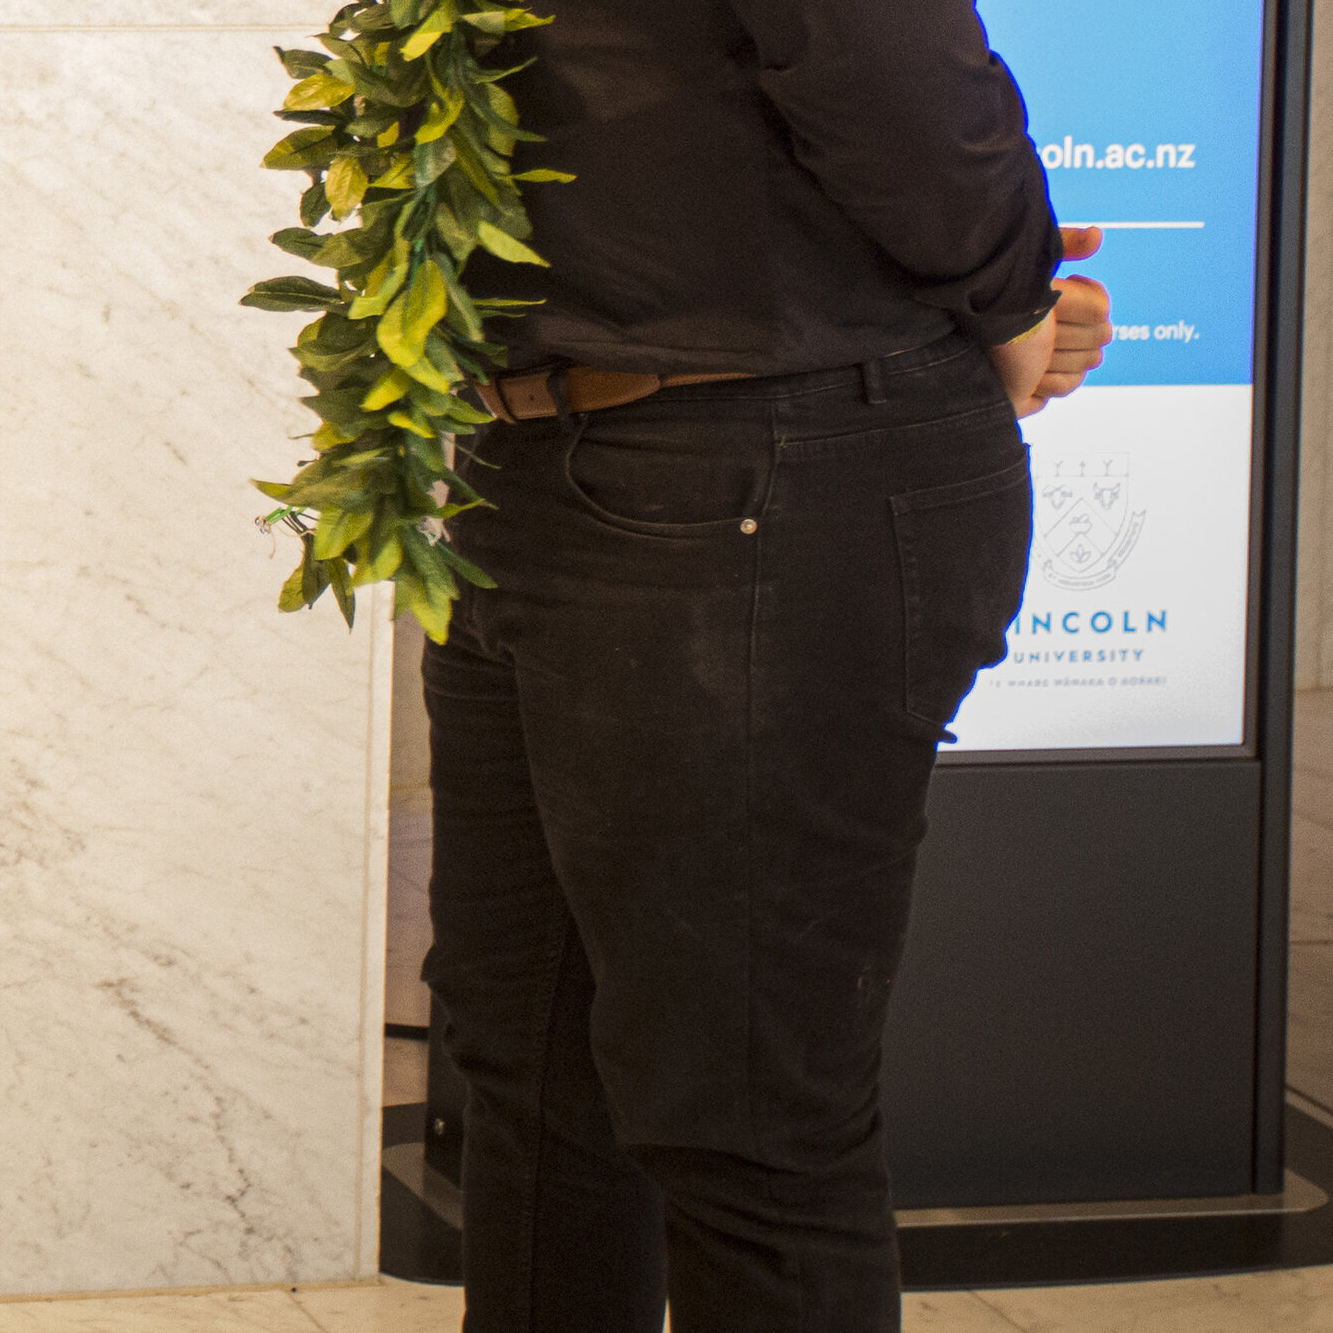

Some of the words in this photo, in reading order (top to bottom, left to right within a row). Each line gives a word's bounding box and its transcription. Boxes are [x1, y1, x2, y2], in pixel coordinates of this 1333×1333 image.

[1037, 135, 1195, 169] oln.ac.nz
[1112, 324, 1149, 341] rses
[1154, 320, 1200, 343] only.
[1014, 610, 1166, 635] INCOLN
[1014, 648, 1145, 663] UNIVERSITY
